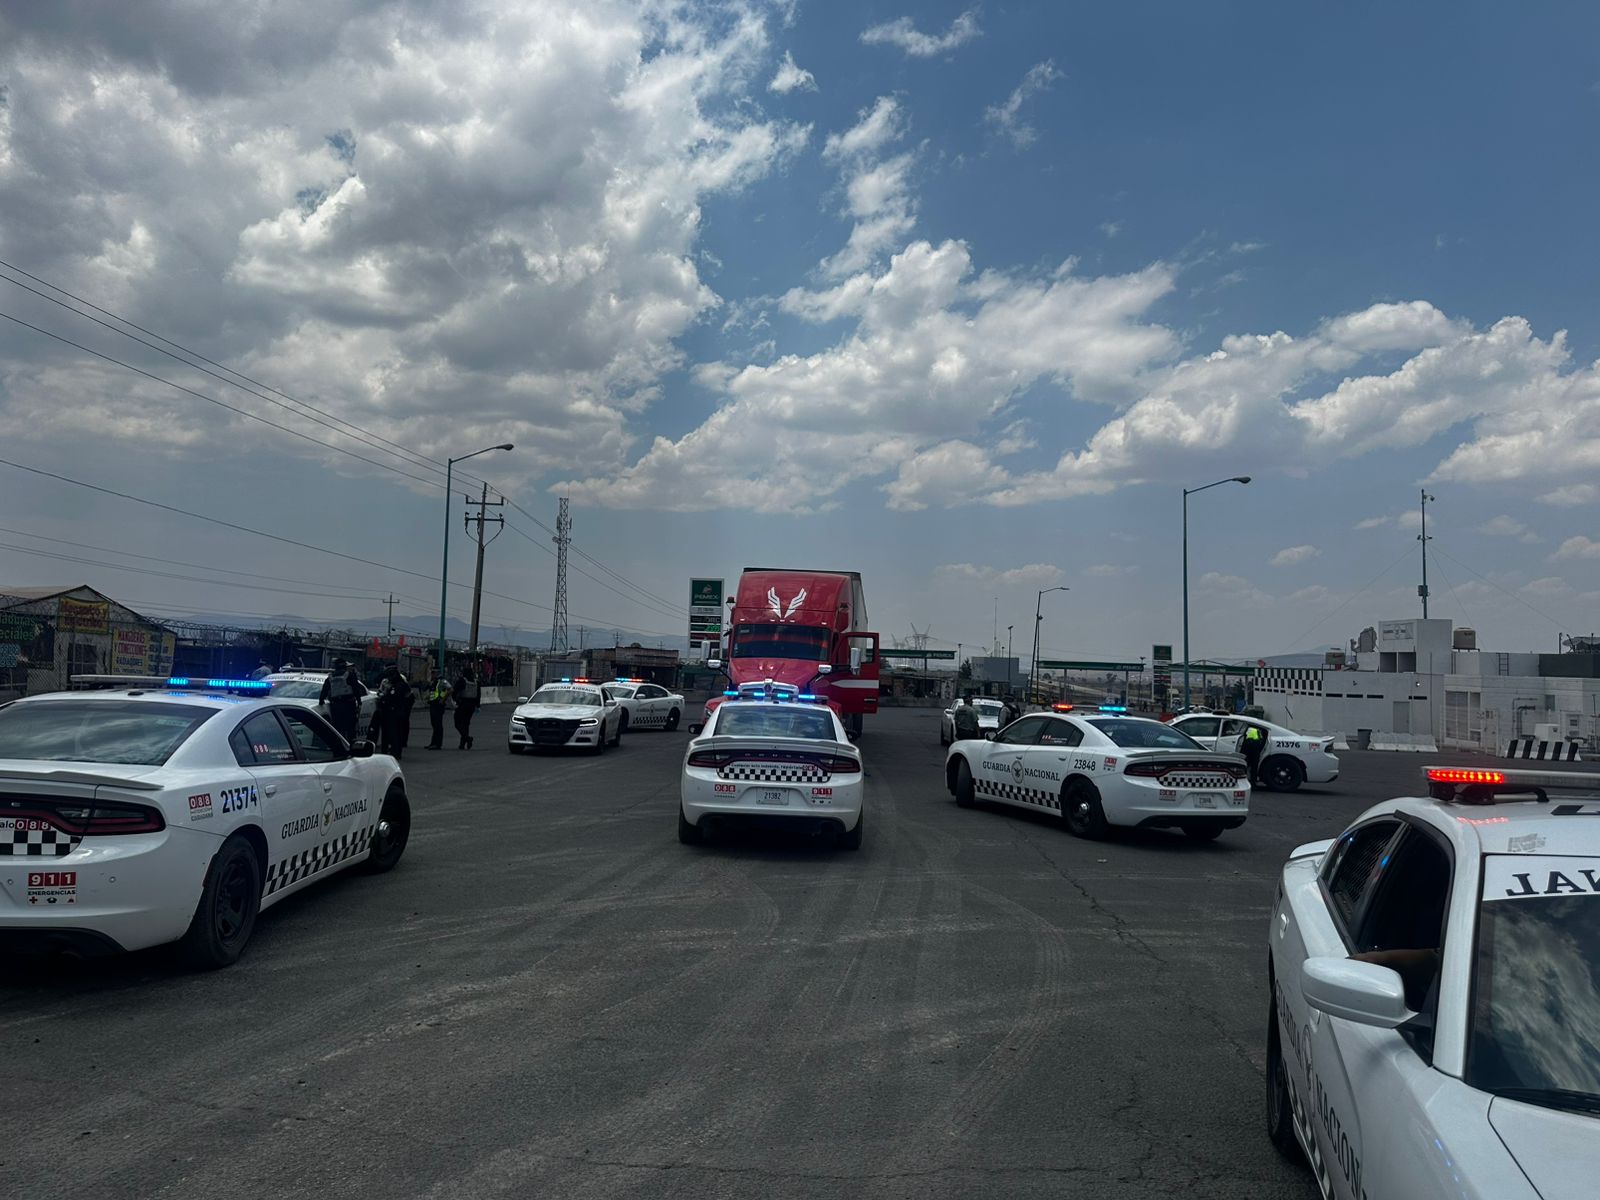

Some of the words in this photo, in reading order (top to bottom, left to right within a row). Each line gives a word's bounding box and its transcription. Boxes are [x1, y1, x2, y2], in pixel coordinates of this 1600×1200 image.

[982, 761, 1011, 773] GUARDIA
[1024, 768, 1060, 781] NACIONAL
[1073, 759, 1096, 771] 23848
[189, 795, 211, 809] 088
[220, 785, 257, 814] 21374
[764, 791, 781, 800] 21382
[16, 820, 50, 831] 088
[281, 813, 319, 840] GUARDIA
[333, 799, 367, 822] NACIONAL
[30, 873, 74, 887] 911
[1315, 1073, 1368, 1200] NACION
